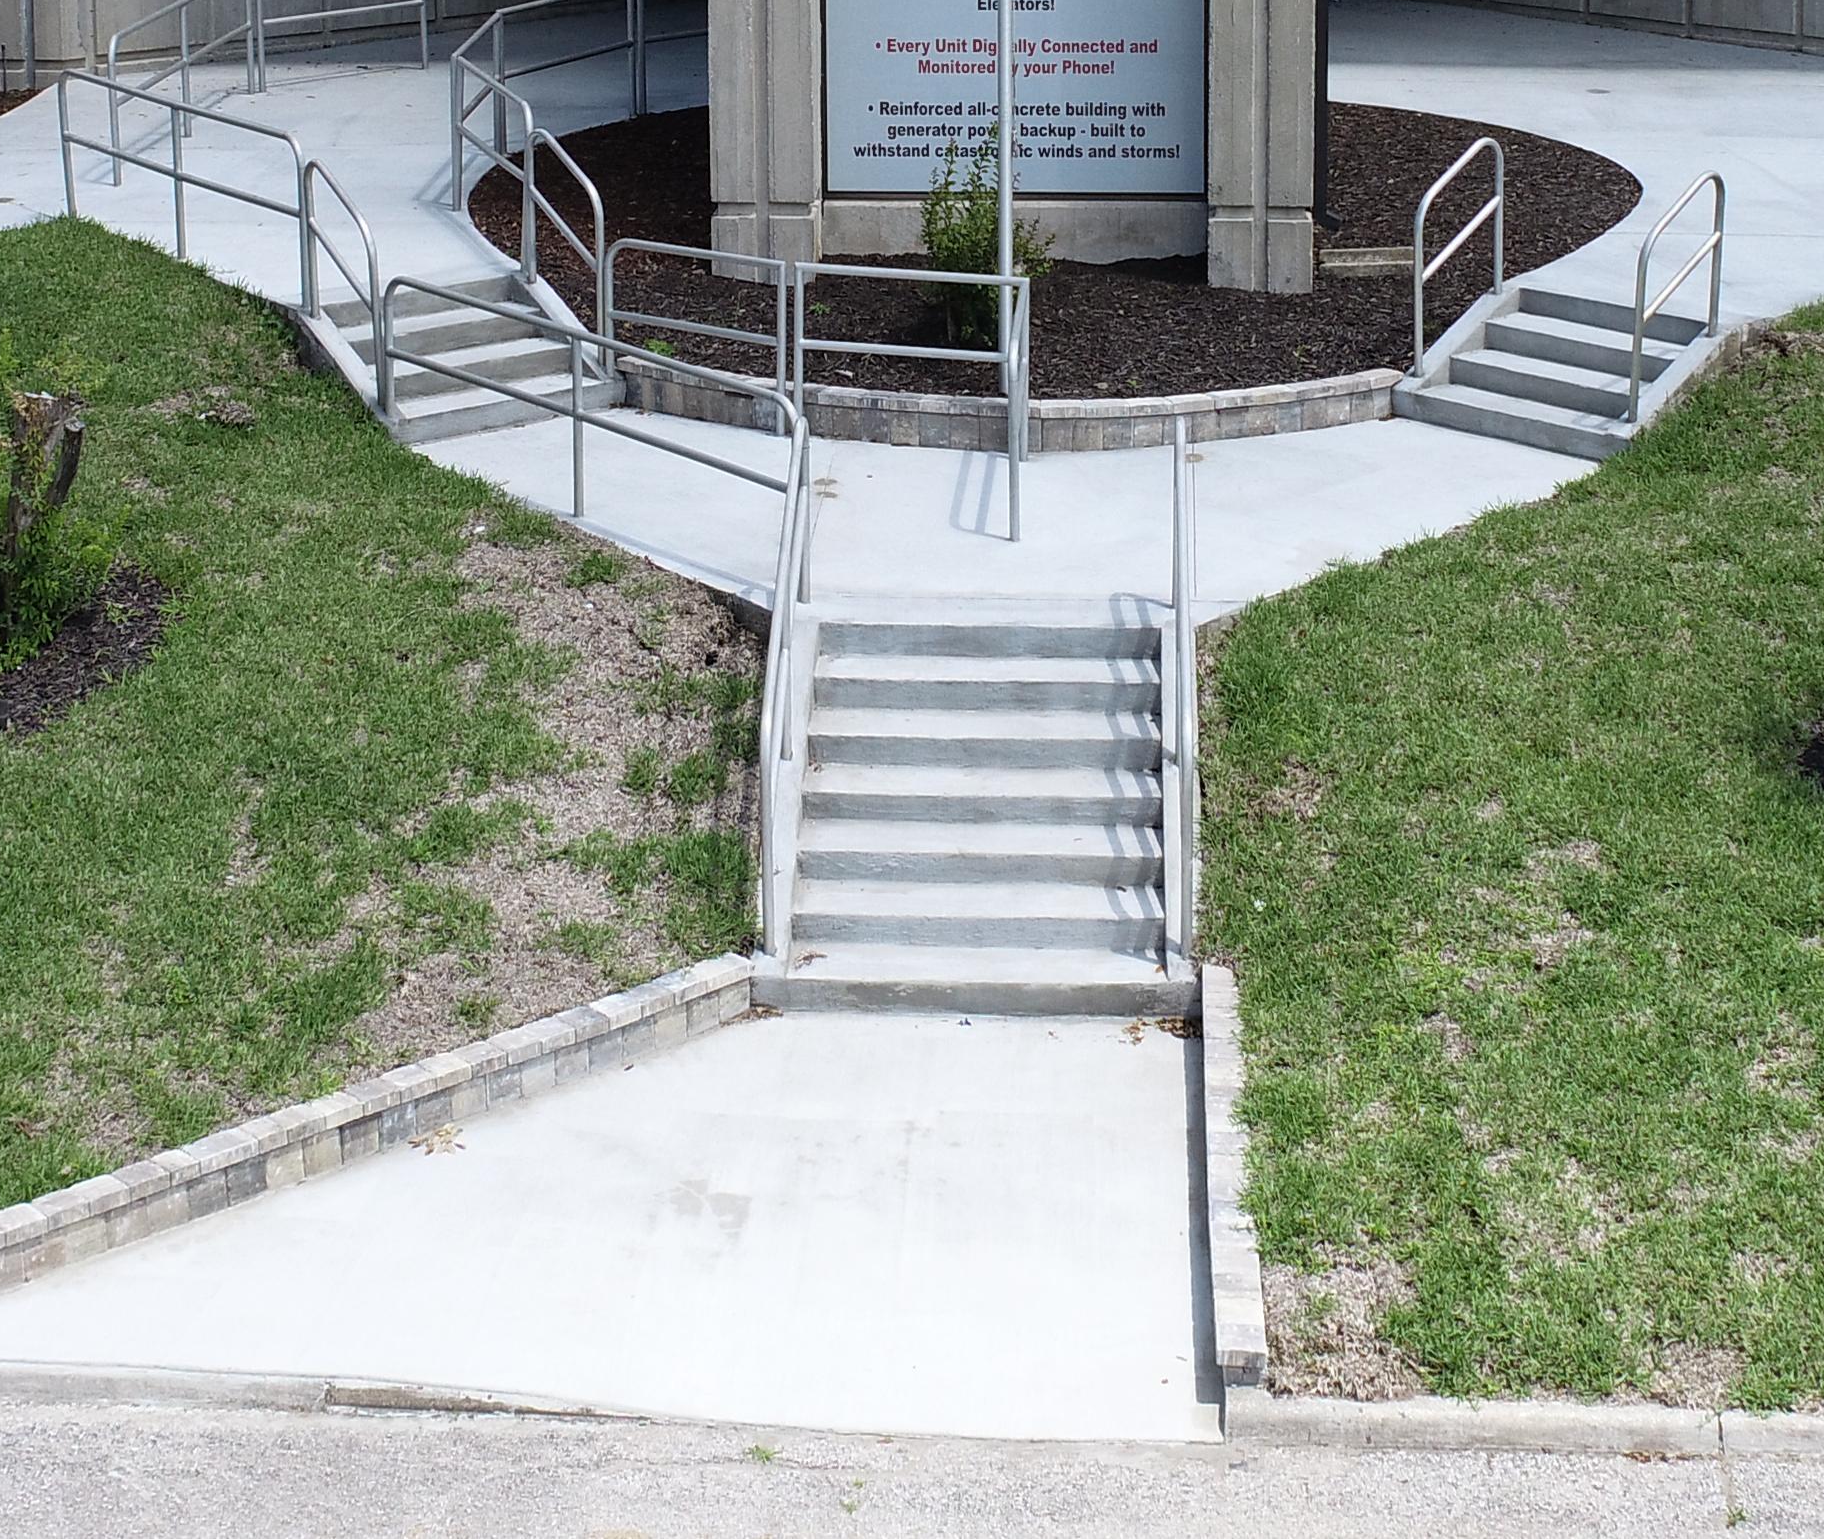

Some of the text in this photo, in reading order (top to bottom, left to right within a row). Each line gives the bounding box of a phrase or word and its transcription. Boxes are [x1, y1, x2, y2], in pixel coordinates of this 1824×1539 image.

[887, 38, 931, 56] Every
[936, 38, 968, 53] Unit
[1041, 38, 1125, 54] Connected
[1129, 39, 1158, 54] and
[918, 60, 996, 74] Monitored
[1023, 63, 1058, 78] your
[1062, 60, 1115, 75] Phone!
[879, 101, 1166, 120] Reinforced all-cncrete building with
[887, 123, 964, 141] generator
[1020, 122, 1077, 140] backup
[1090, 122, 1126, 138] built
[1130, 123, 1146, 138] to
[853, 143, 930, 158] withstand
[1038, 143, 1084, 159] winds
[1088, 144, 1117, 159] and
[1121, 144, 1181, 159] storms!
